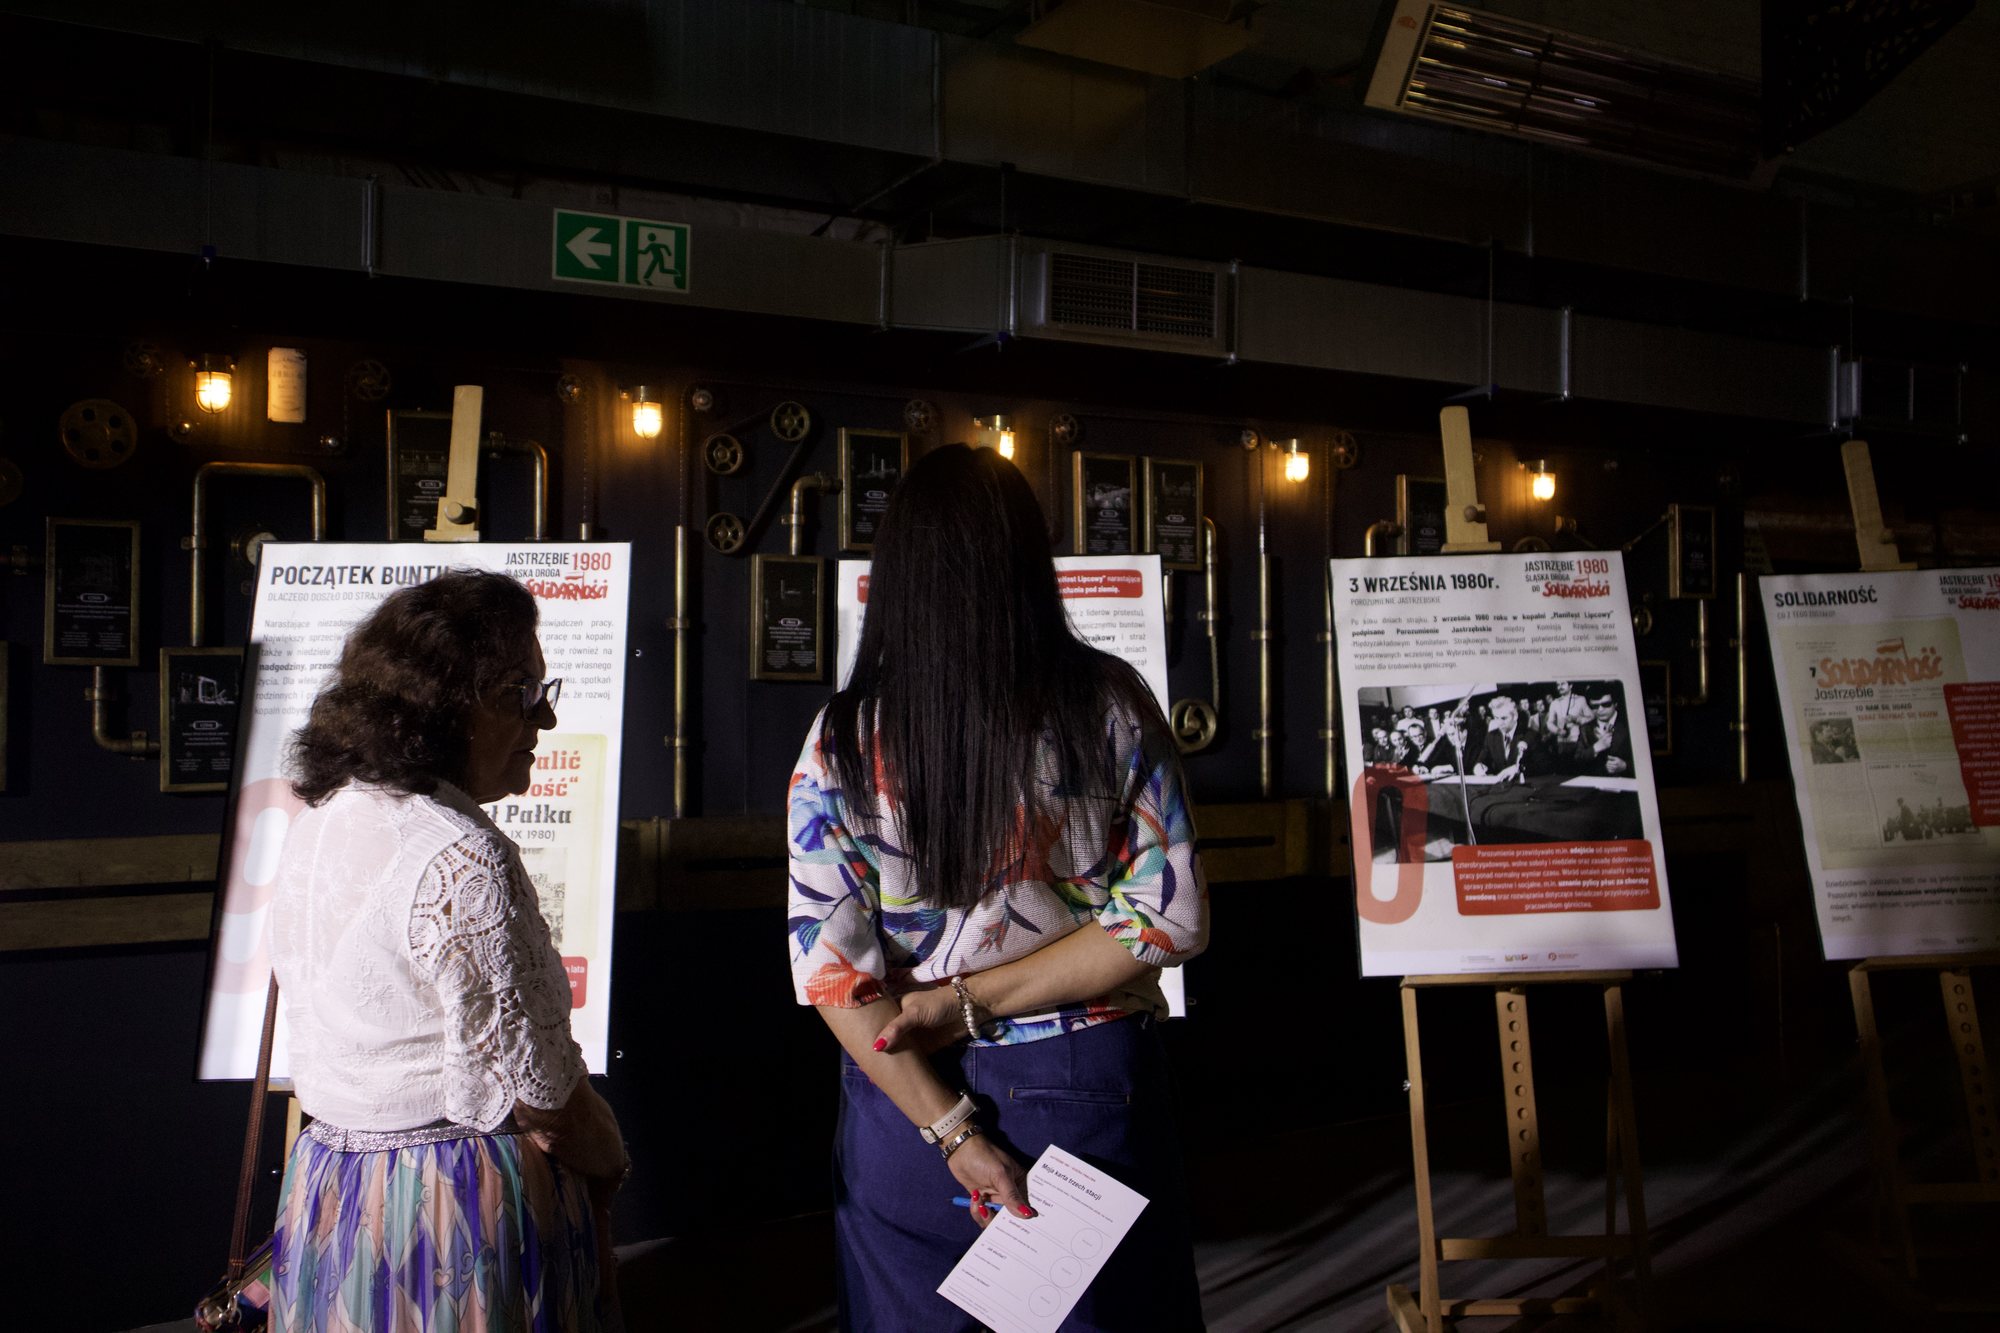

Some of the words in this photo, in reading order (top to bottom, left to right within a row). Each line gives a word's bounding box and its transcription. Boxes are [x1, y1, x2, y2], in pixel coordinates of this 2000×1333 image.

[505, 552, 570, 566] JASTRZĘBIE
[572, 552, 612, 571] 1980
[1524, 560, 1575, 574] JASTRZĘBIE
[1576, 558, 1609, 574] 1980
[271, 565, 376, 590] POCZĄTEK
[535, 568, 560, 577] DROGA
[1525, 573, 1549, 583] ŚLĄSKA
[1550, 573, 1570, 582] DROGA
[1349, 577, 1359, 593] 3
[1363, 571, 1446, 593] WRZEŚNIA
[1450, 573, 1500, 591] 1980r.
[1939, 574, 1985, 587] JASTRZĘBIE
[1085, 586, 1097, 594] pod
[1774, 584, 1878, 608] SOLIDARNOŚĆ
[268, 592, 308, 602] DLACZEGO
[310, 592, 340, 602] DOSZŁO
[343, 591, 354, 602] DO
[264, 619, 310, 631] Narastające
[546, 633, 567, 642] pracę
[572, 633, 582, 641] na
[586, 632, 613, 642] kopalni
[1396, 627, 1440, 636] Porozumienie
[262, 632, 304, 644] Największy
[553, 646, 565, 656] się
[569, 646, 599, 655] również
[575, 660, 612, 671] własnego
[580, 676, 611, 685] spotkań
[573, 690, 582, 699] że
[1814, 687, 1874, 701] Jastrzębie
[504, 804, 572, 824] Pałka
[510, 830, 522, 840] IX
[527, 830, 556, 842] 1980)
[1041, 1163, 1055, 1177] Moja
[1054, 1168, 1069, 1182] karta
[1068, 1177, 1086, 1192] trzech
[1085, 1186, 1102, 1201] stacji
